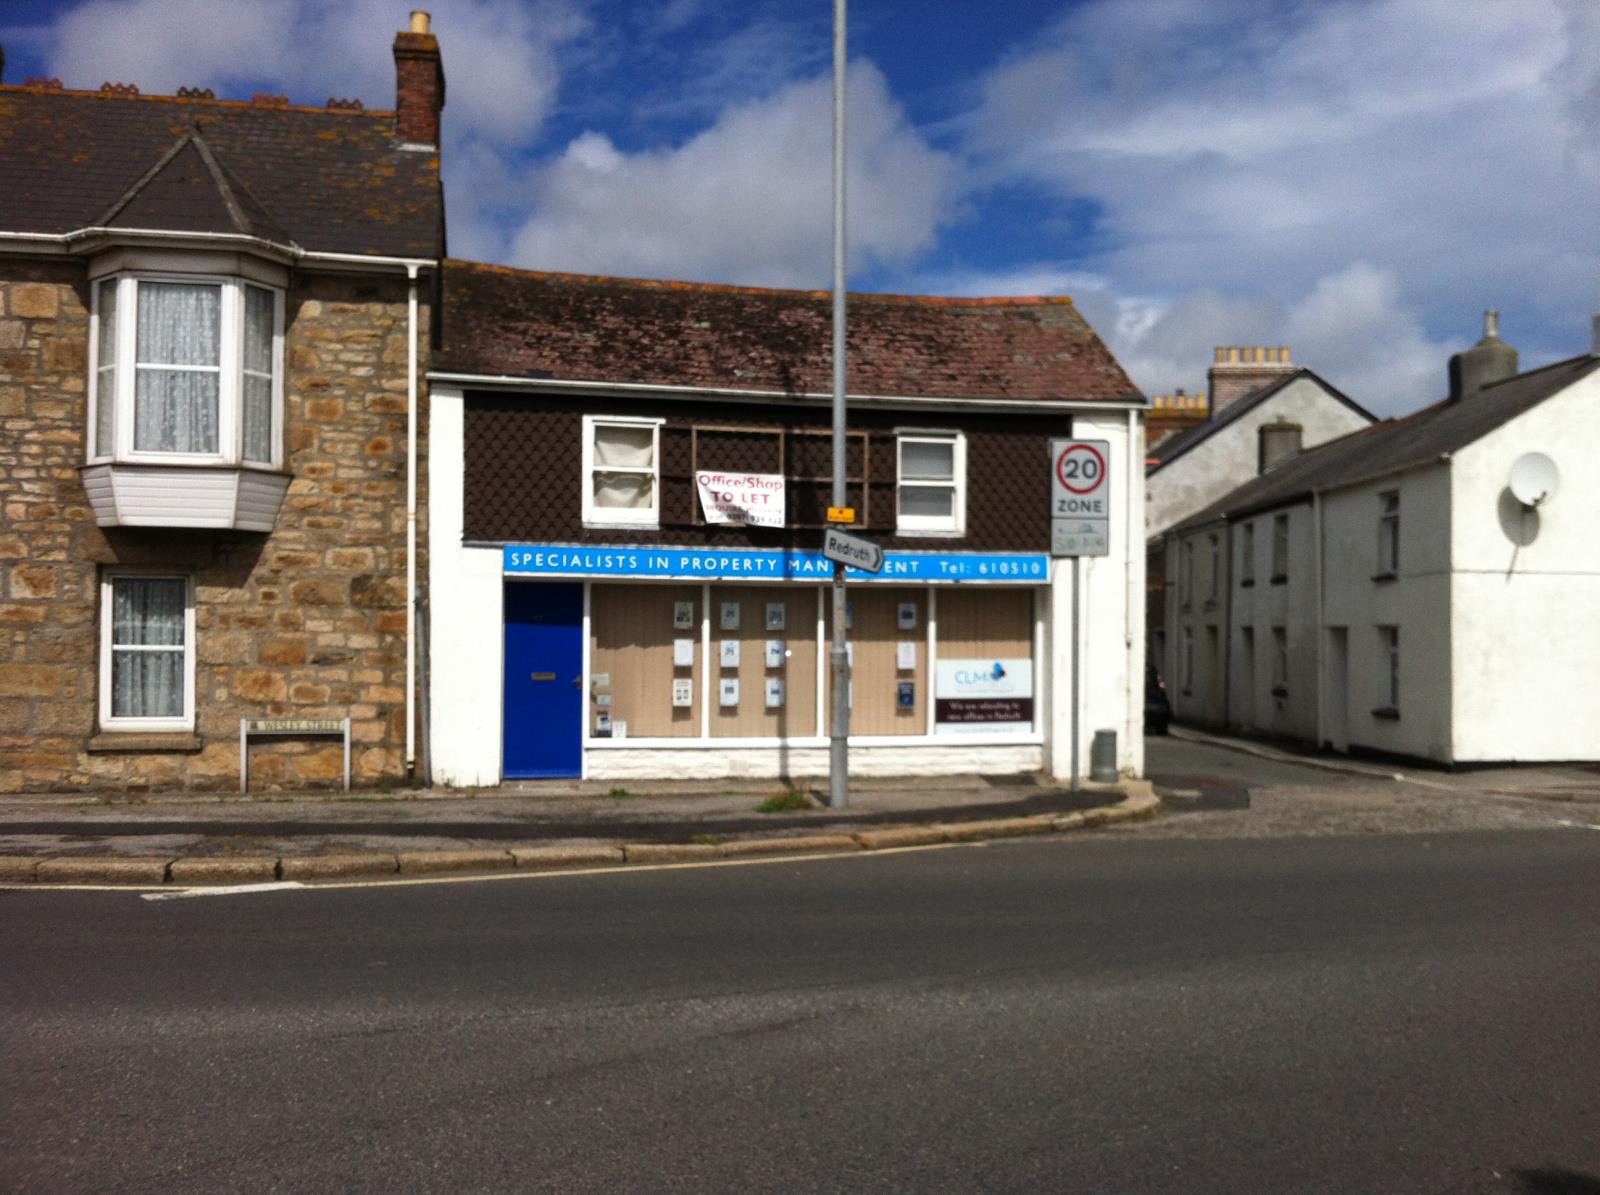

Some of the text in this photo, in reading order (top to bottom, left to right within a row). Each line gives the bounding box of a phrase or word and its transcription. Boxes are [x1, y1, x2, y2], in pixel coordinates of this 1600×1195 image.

[1064, 459, 1098, 479] 20
[699, 474, 783, 492] Office/Shop
[710, 491, 770, 505] TO LET
[1057, 500, 1102, 513] ZONE
[829, 537, 872, 561] Redruth
[511, 552, 638, 569] SPECIALISTS
[648, 556, 669, 569] IN
[680, 557, 777, 571] PROPERTY
[788, 559, 919, 574] MANENT
[978, 561, 1040, 574] 610510
[307, 720, 343, 731] STREET
